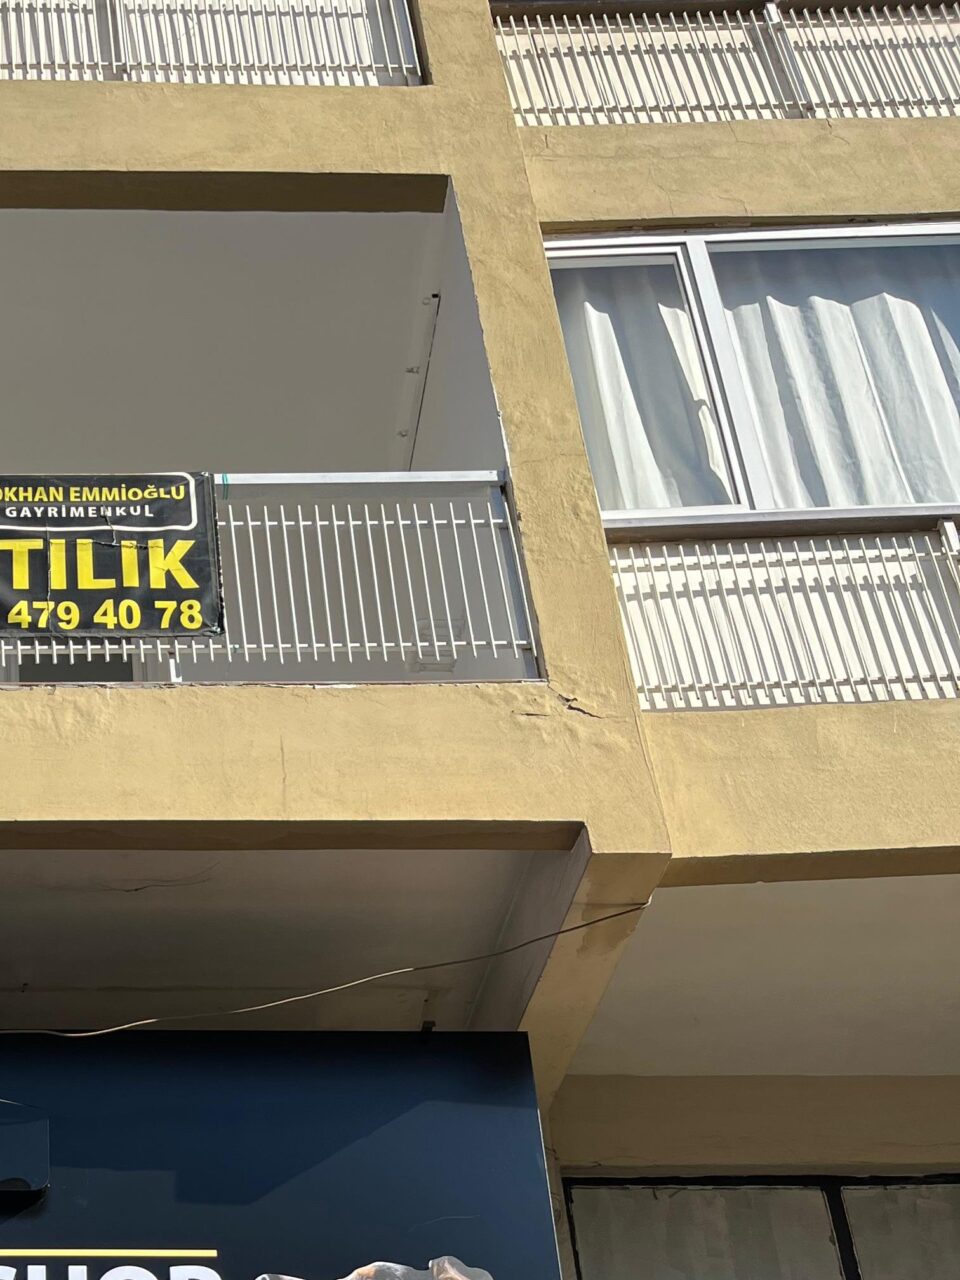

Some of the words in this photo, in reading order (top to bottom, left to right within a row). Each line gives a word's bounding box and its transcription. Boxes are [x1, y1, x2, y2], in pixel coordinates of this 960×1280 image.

[69, 483, 185, 502] EMMİOĞLU
[5, 505, 154, 518] GAYRİMENKUL
[7, 599, 81, 630] 479
[93, 599, 142, 630] 40
[153, 599, 203, 630] 78
